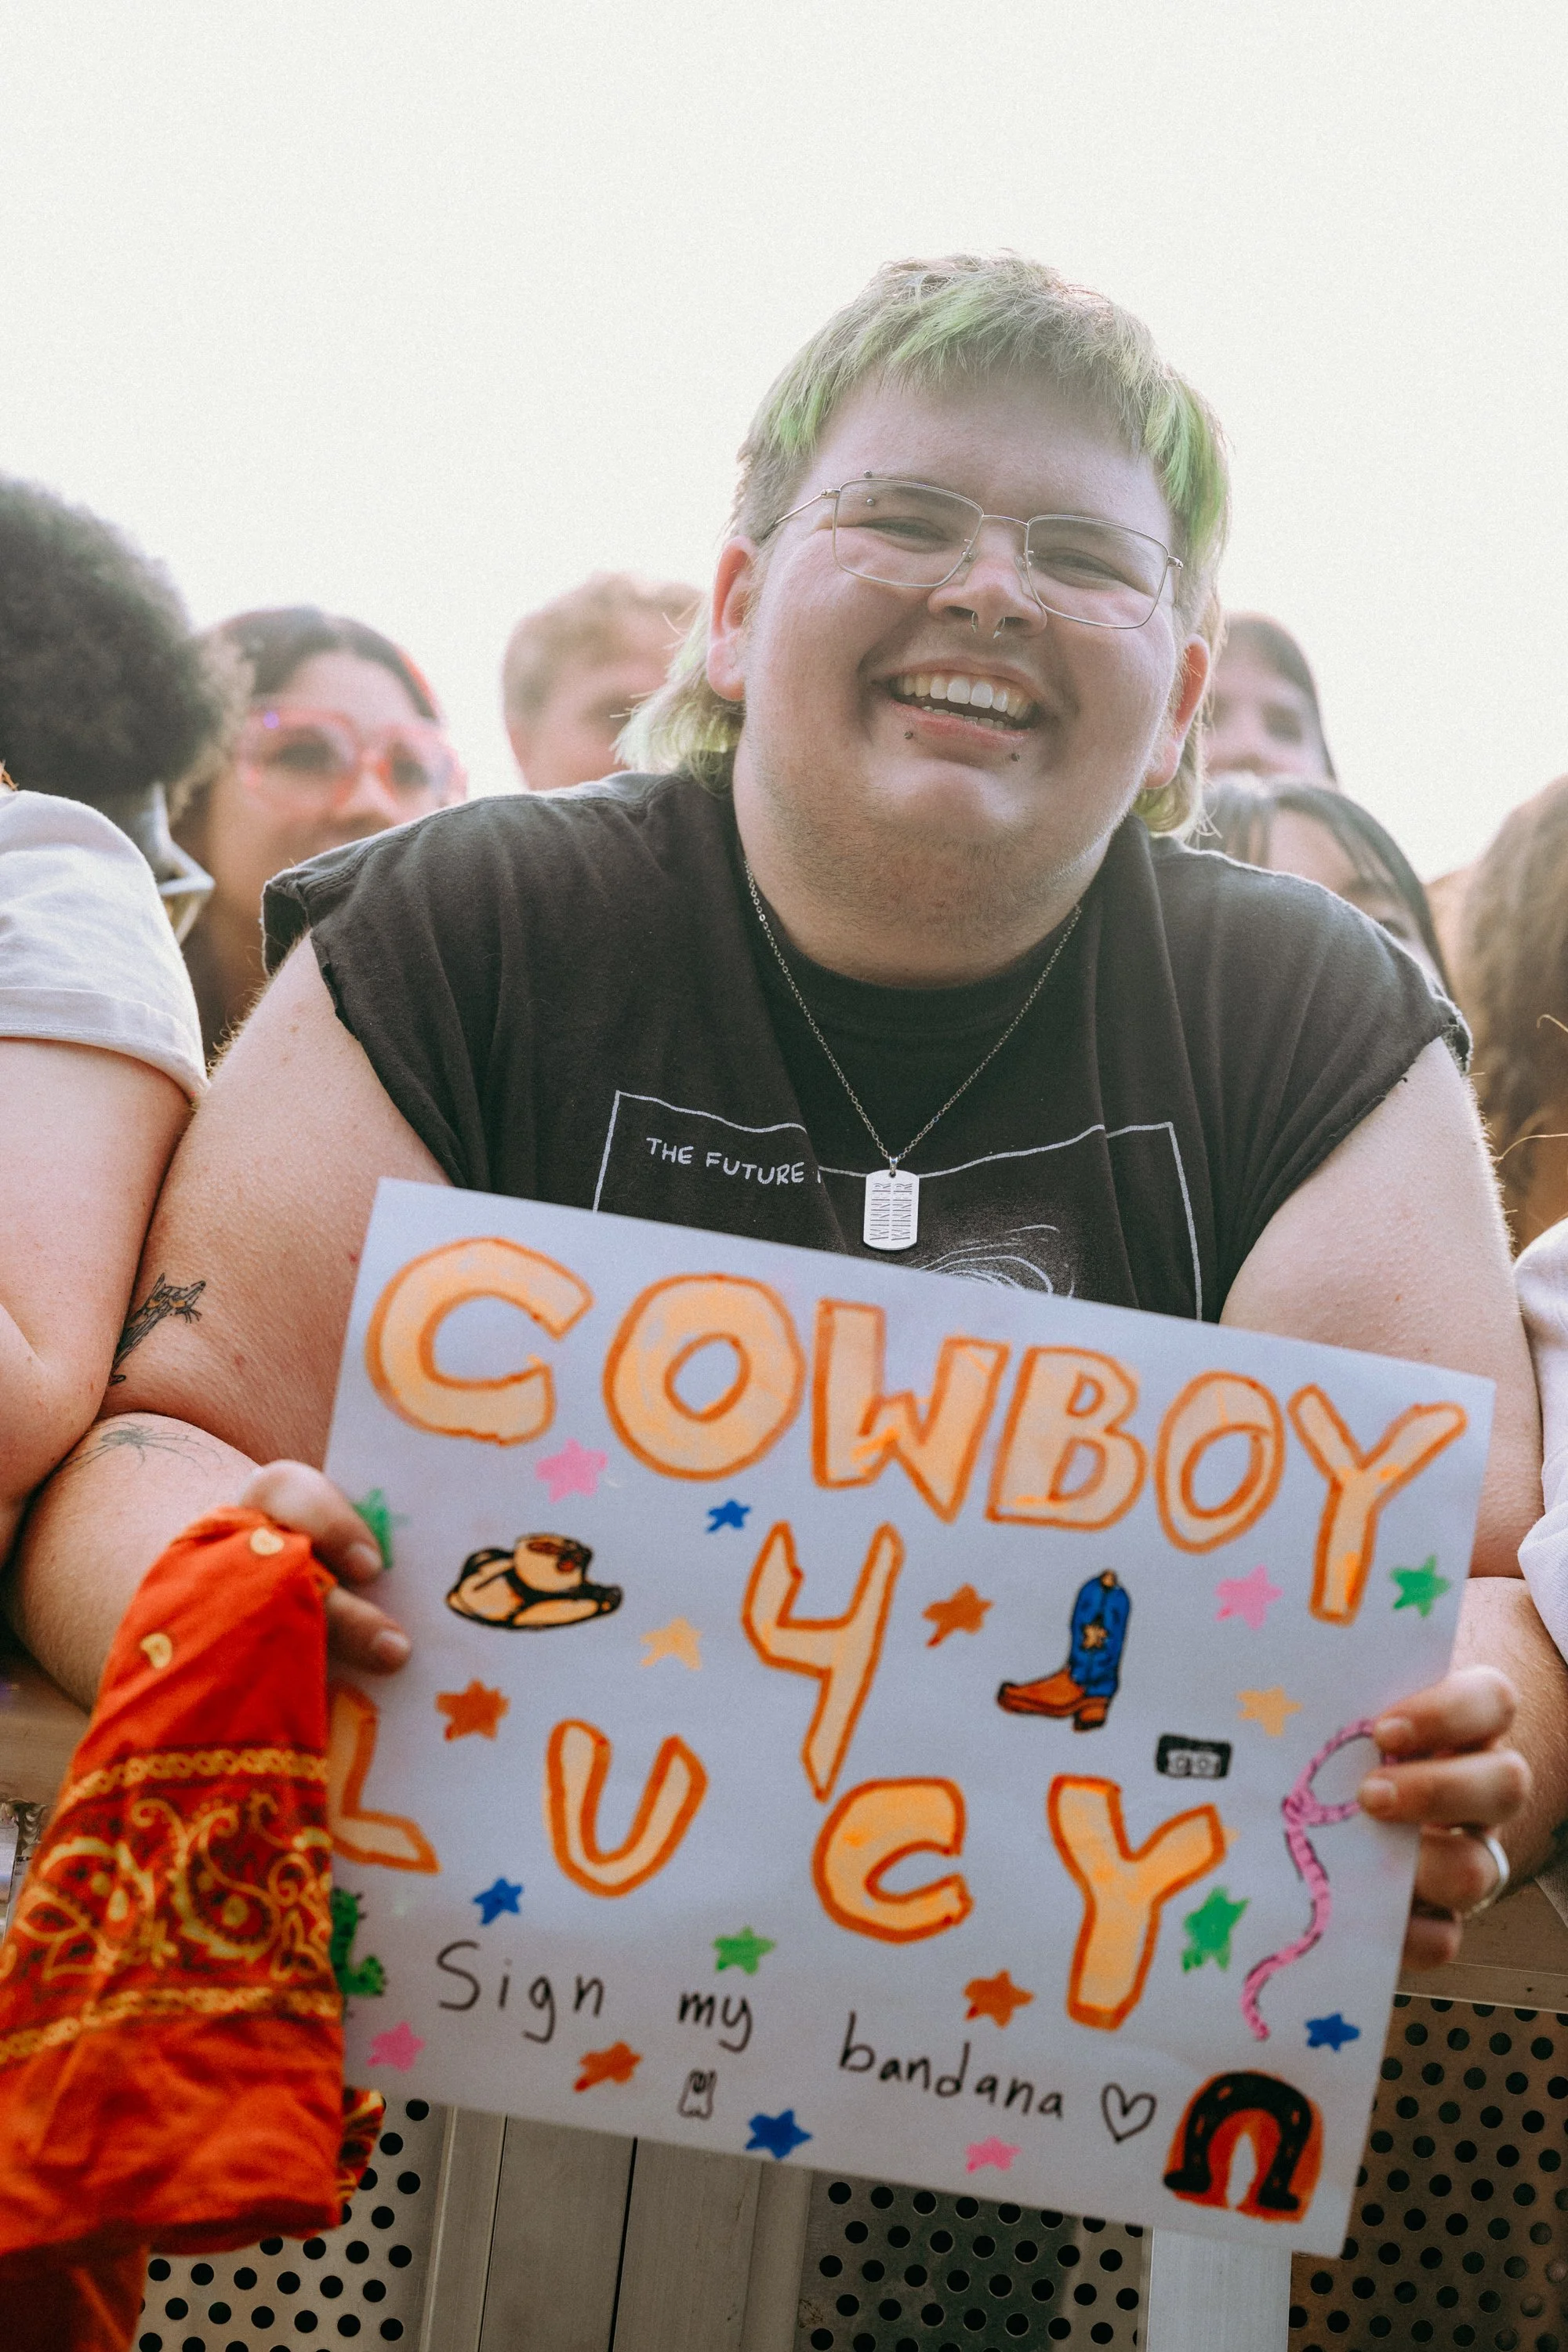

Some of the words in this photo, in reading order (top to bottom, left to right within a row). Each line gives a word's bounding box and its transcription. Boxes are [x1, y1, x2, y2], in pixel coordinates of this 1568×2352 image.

[646, 1137, 694, 1165] THE
[706, 1152, 805, 1186] FUTURE
[869, 1182, 891, 1240] WINNER
[891, 1182, 913, 1241] WINNER
[365, 1236, 1468, 1628] COWBOY
[742, 1522, 906, 1803] 4
[326, 1682, 1228, 2032] LUCY
[436, 1940, 605, 2043] Sign
[677, 1990, 754, 2053] my
[838, 2011, 1065, 2119] bandana
